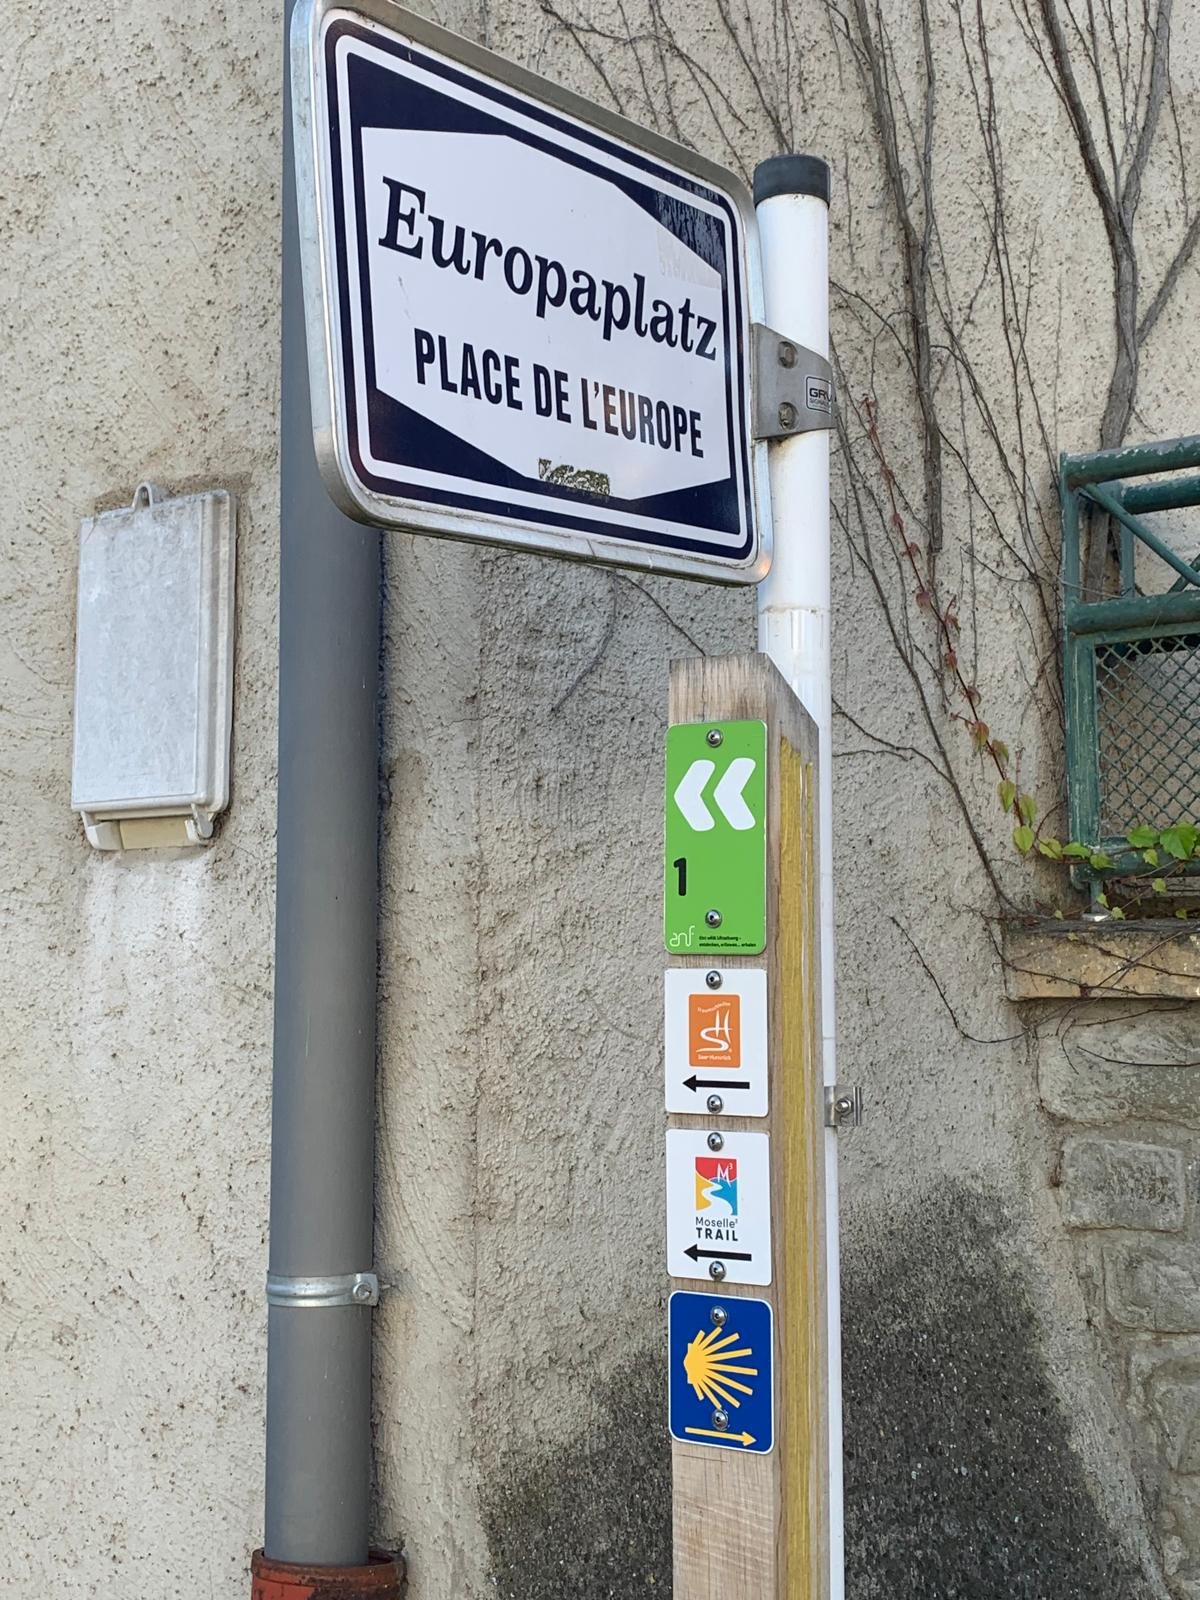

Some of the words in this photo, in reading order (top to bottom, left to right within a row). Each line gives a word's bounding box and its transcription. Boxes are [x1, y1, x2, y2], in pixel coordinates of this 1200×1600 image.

[377, 175, 719, 361] Europaplatz
[413, 327, 523, 411] PLACE
[532, 363, 572, 422] DE
[579, 377, 705, 458] L'EUROPE
[673, 857, 687, 896] 1
[695, 1227, 738, 1241] TRAIL
